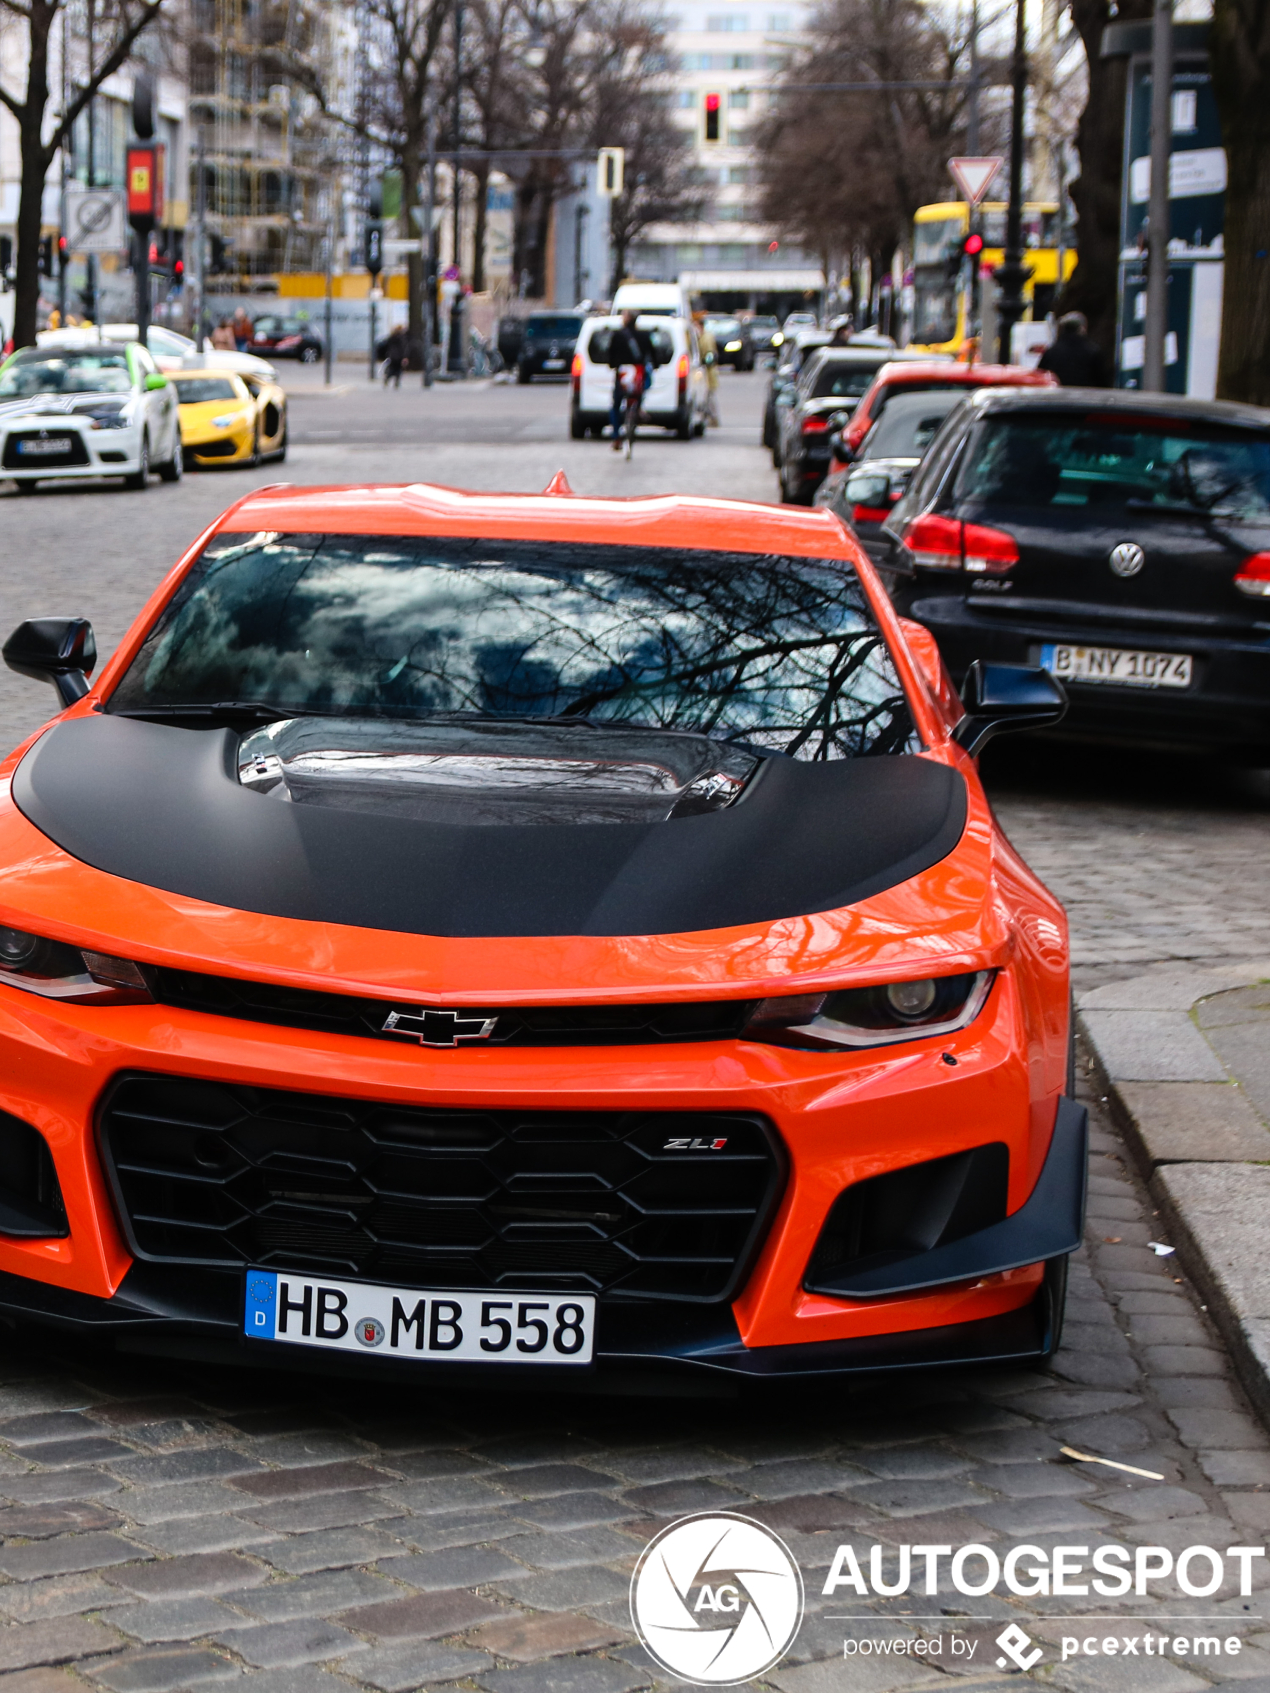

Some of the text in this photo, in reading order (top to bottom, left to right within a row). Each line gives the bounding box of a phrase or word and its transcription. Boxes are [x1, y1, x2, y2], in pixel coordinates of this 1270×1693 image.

[1057, 649, 1187, 680] B NY 1074
[255, 1311, 266, 1326] D
[278, 1281, 349, 1340] HB
[390, 1296, 464, 1351] MB
[479, 1301, 585, 1354] 558
